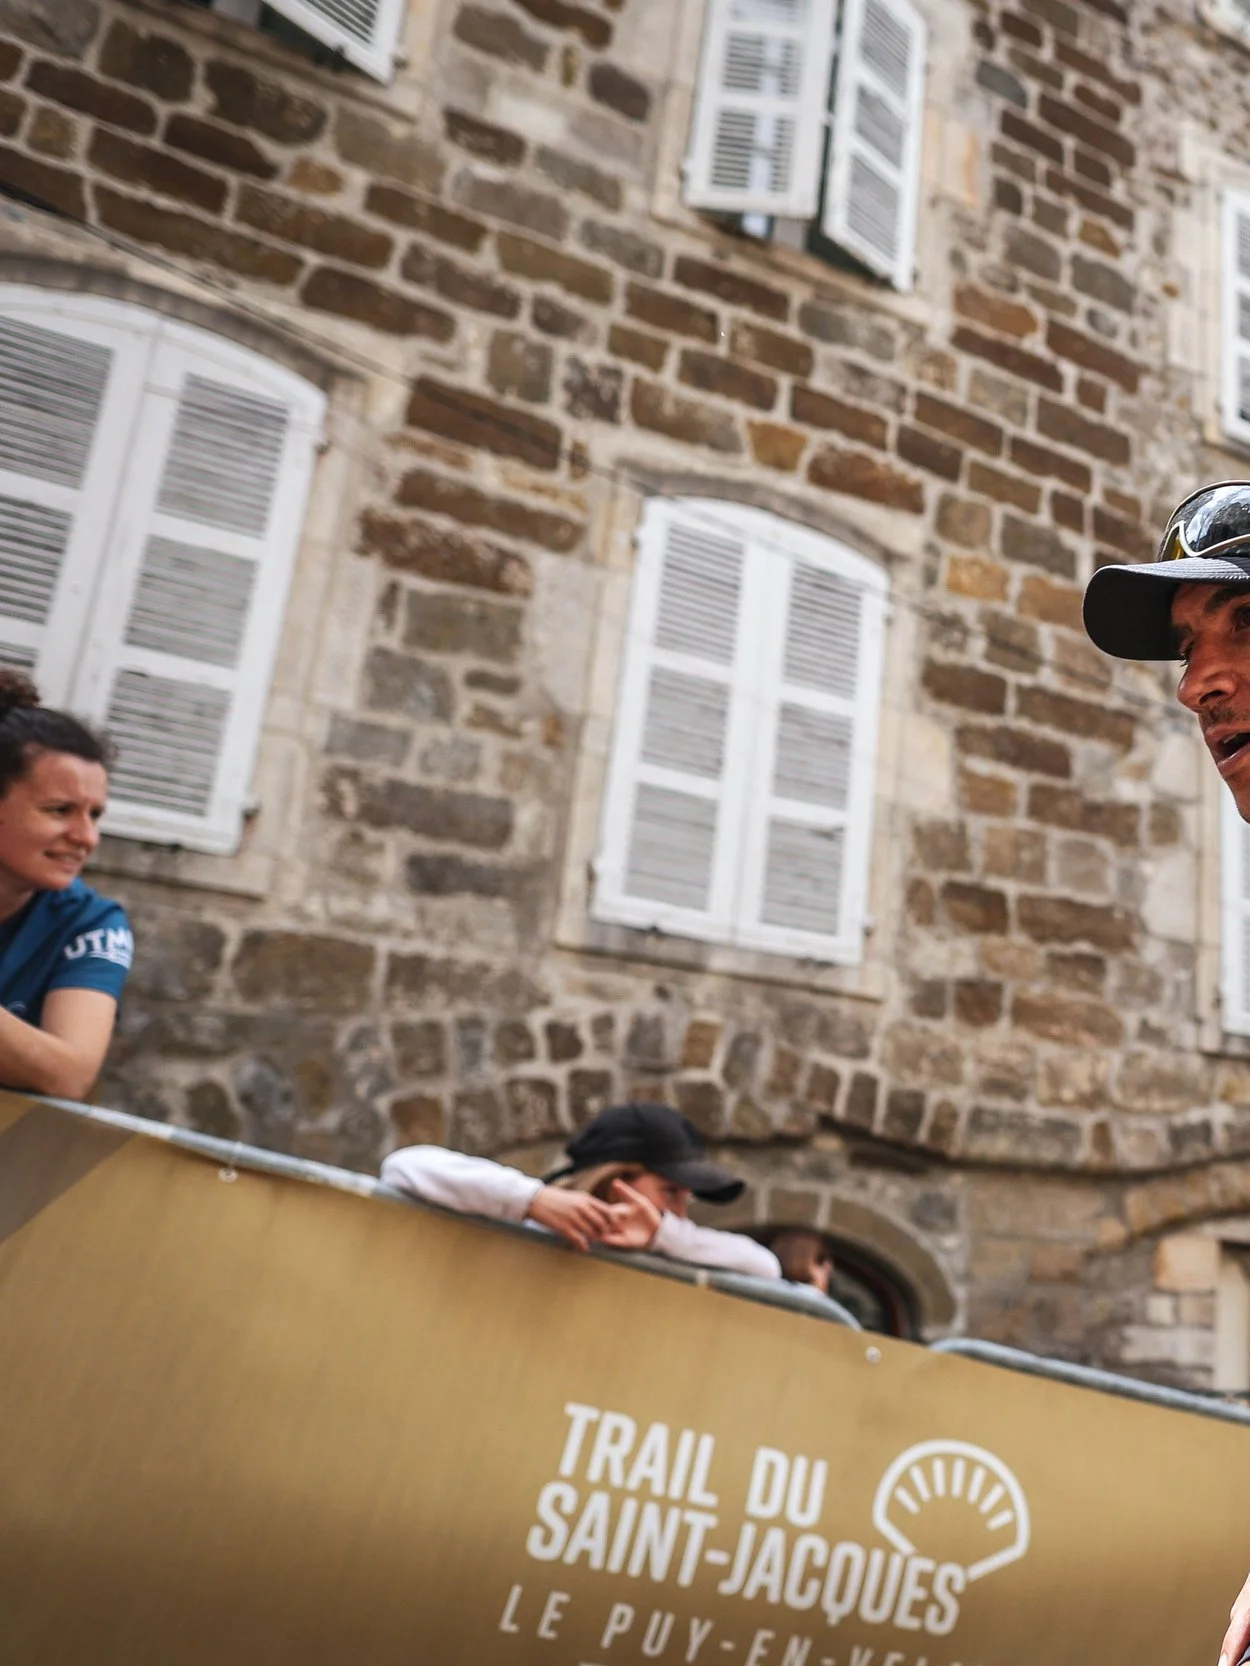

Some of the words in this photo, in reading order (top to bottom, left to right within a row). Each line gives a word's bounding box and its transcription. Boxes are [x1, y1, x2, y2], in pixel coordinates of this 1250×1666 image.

[64, 927, 134, 960] UTM
[557, 1401, 718, 1508] TRAIL
[745, 1446, 828, 1527] DU
[526, 1482, 966, 1635] SAINT-JACQUES
[499, 1584, 570, 1639] LE
